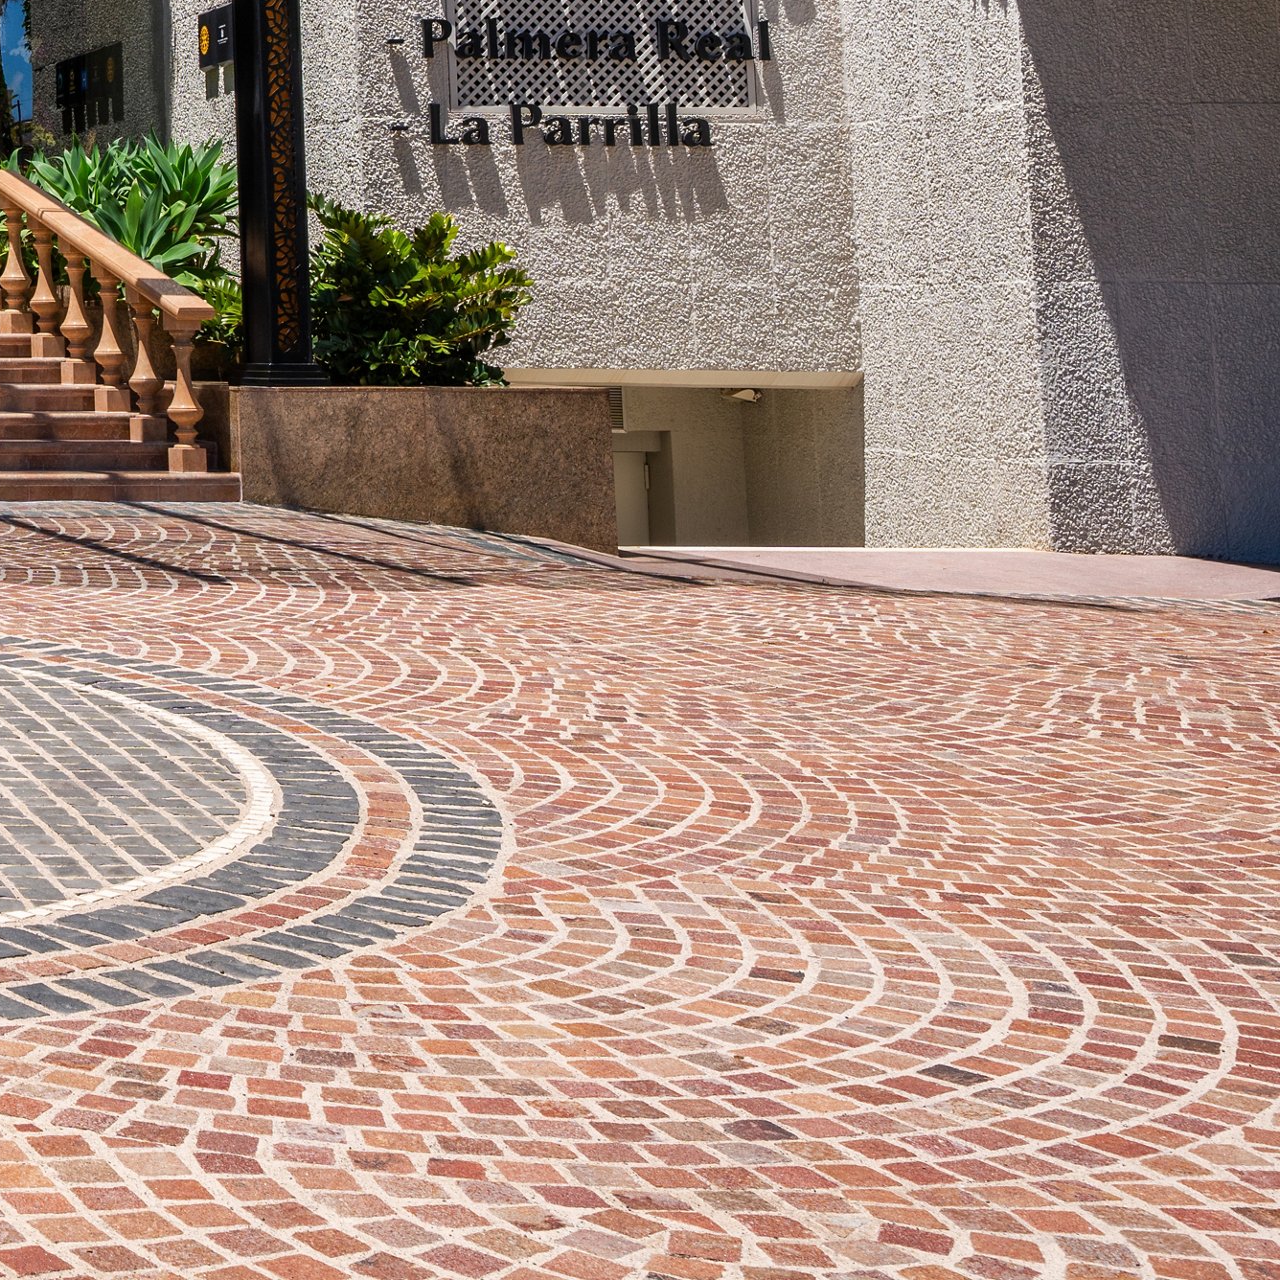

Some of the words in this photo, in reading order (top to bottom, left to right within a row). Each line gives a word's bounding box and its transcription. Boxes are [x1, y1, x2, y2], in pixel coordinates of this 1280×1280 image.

[422, 19, 638, 60] Palmera
[656, 20, 771, 60] Real
[429, 103, 490, 146] La
[510, 103, 714, 146] Parrilla
